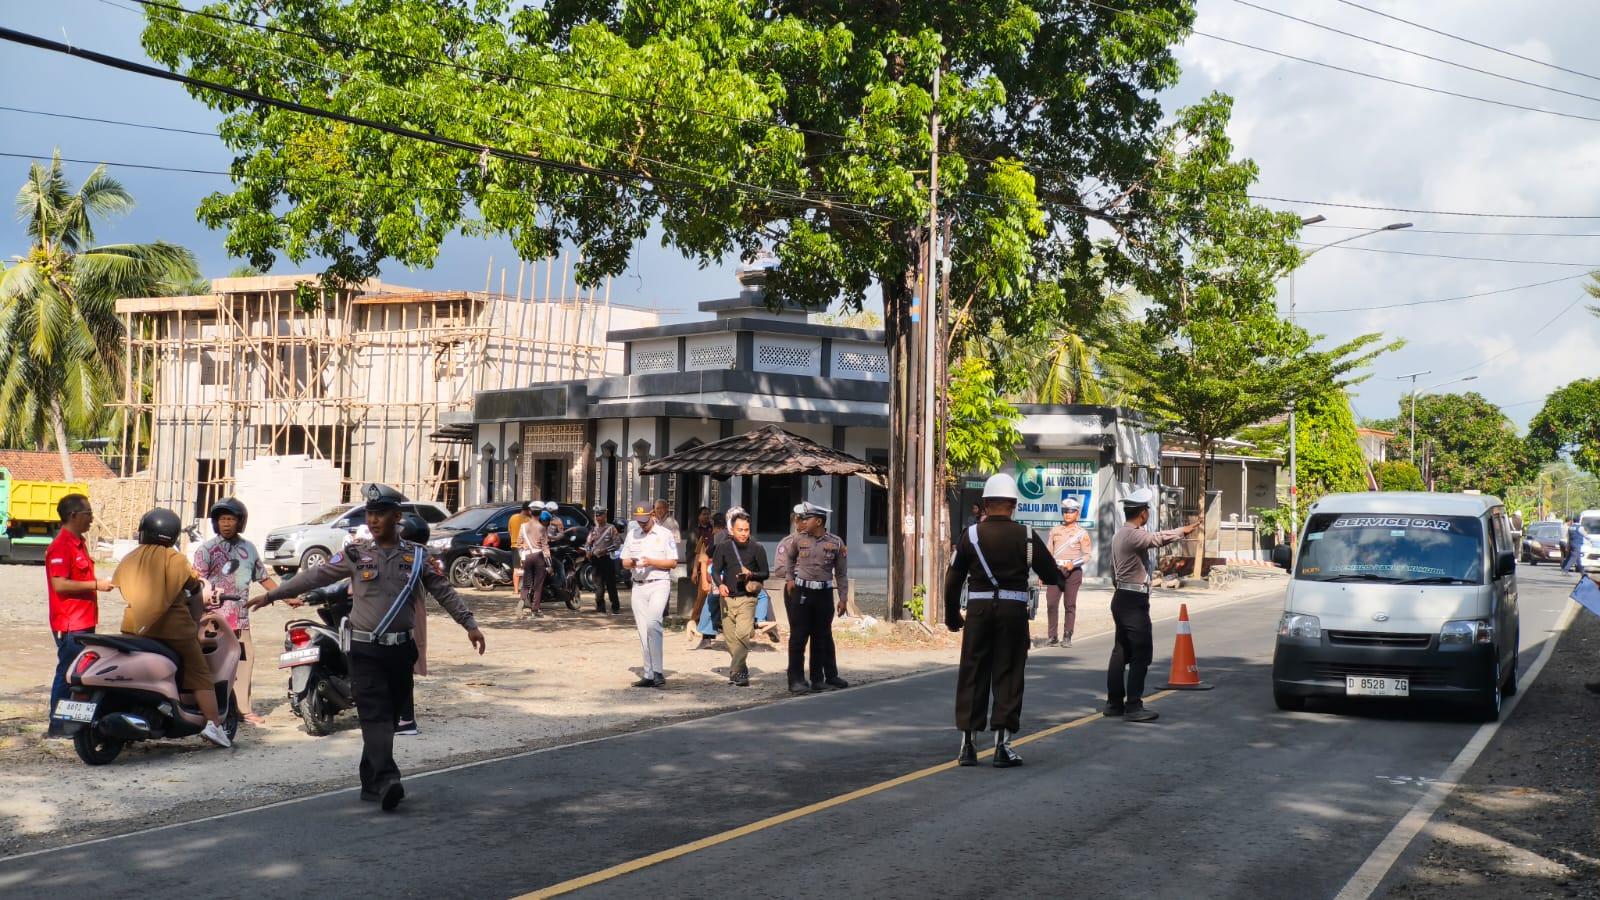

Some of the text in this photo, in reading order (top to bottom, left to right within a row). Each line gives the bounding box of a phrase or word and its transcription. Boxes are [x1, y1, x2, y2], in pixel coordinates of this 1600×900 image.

[1048, 462, 1092, 475] MUSHOLA
[1046, 476, 1055, 487] AL
[1018, 503, 1058, 513] SALJU JAYA
[1334, 517, 1451, 531] SERVICE CAR
[1348, 678, 1407, 691] D 8528 ZG
